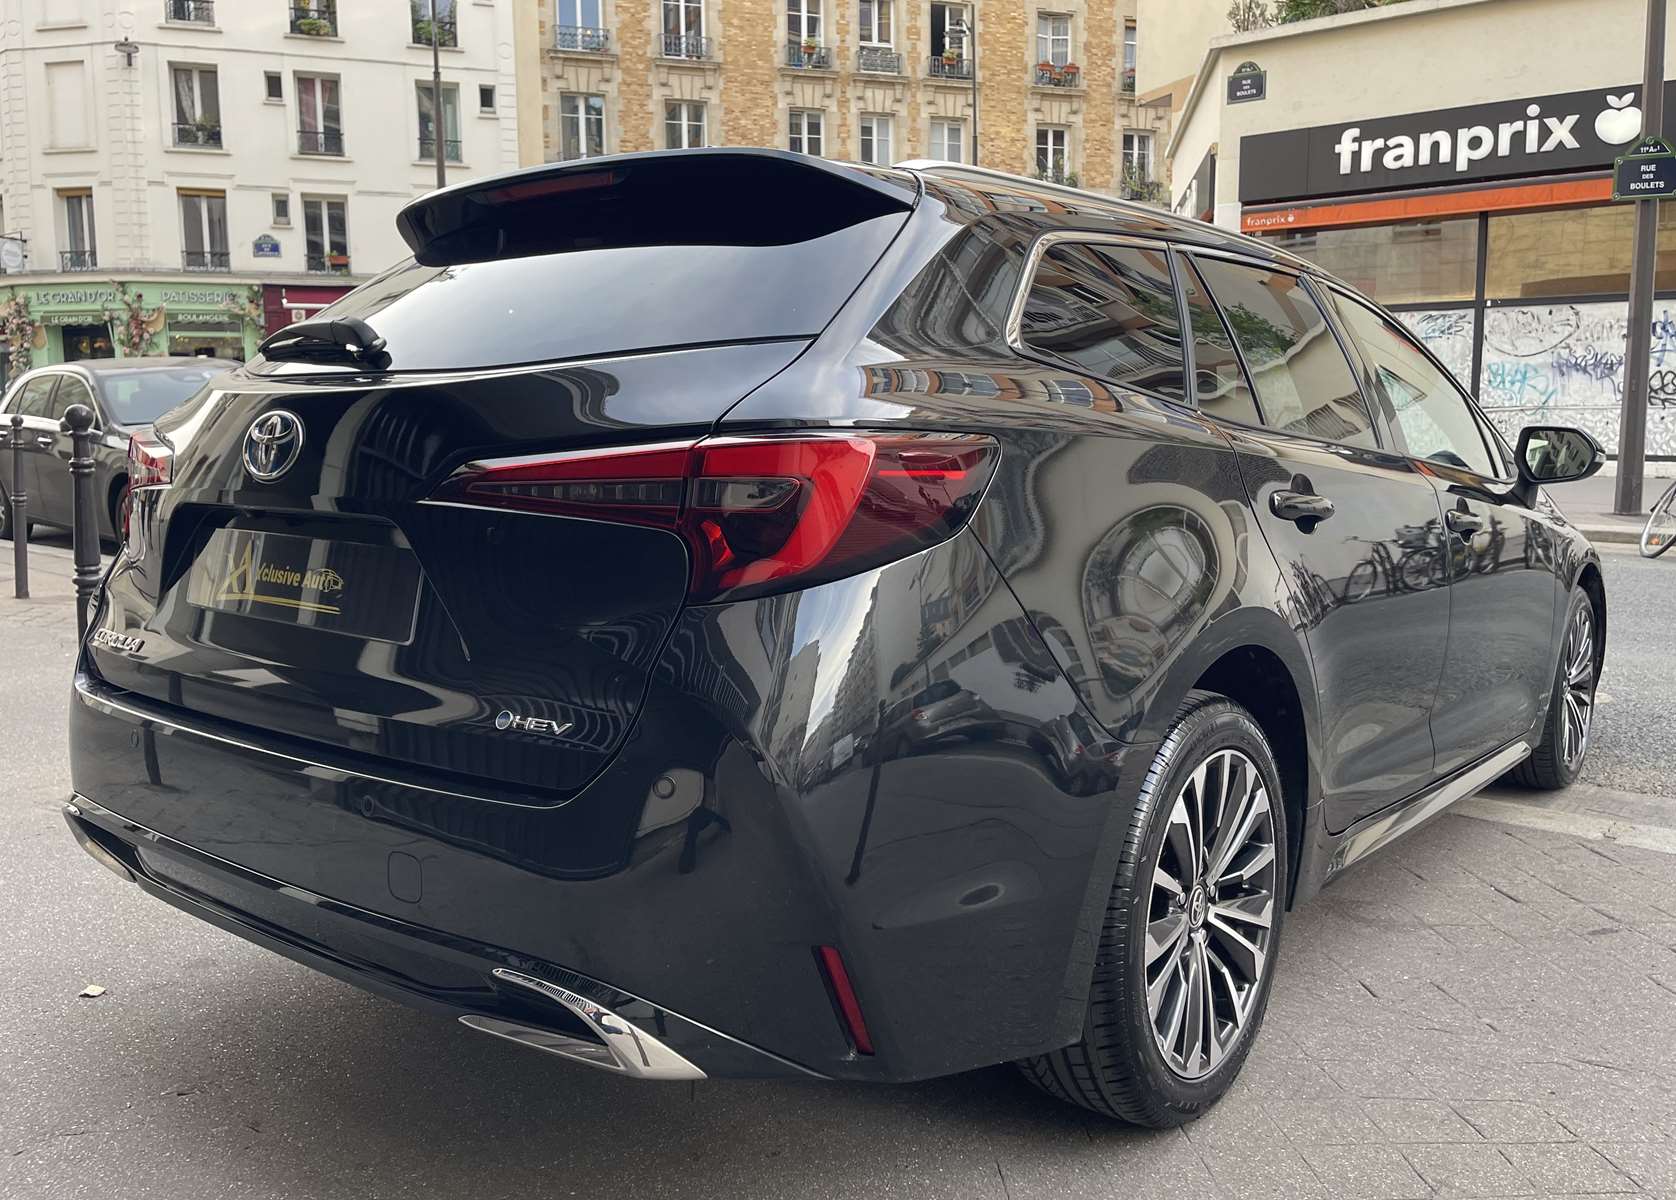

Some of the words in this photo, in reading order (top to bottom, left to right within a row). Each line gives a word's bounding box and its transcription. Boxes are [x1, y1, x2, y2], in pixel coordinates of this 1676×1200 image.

[1335, 104, 1580, 174] franprix
[1630, 181, 1664, 189] BOULETS
[1247, 215, 1286, 226] franprix
[36, 292, 49, 304] LE
[94, 628, 142, 653] COROLLA
[513, 716, 572, 735] HEV
